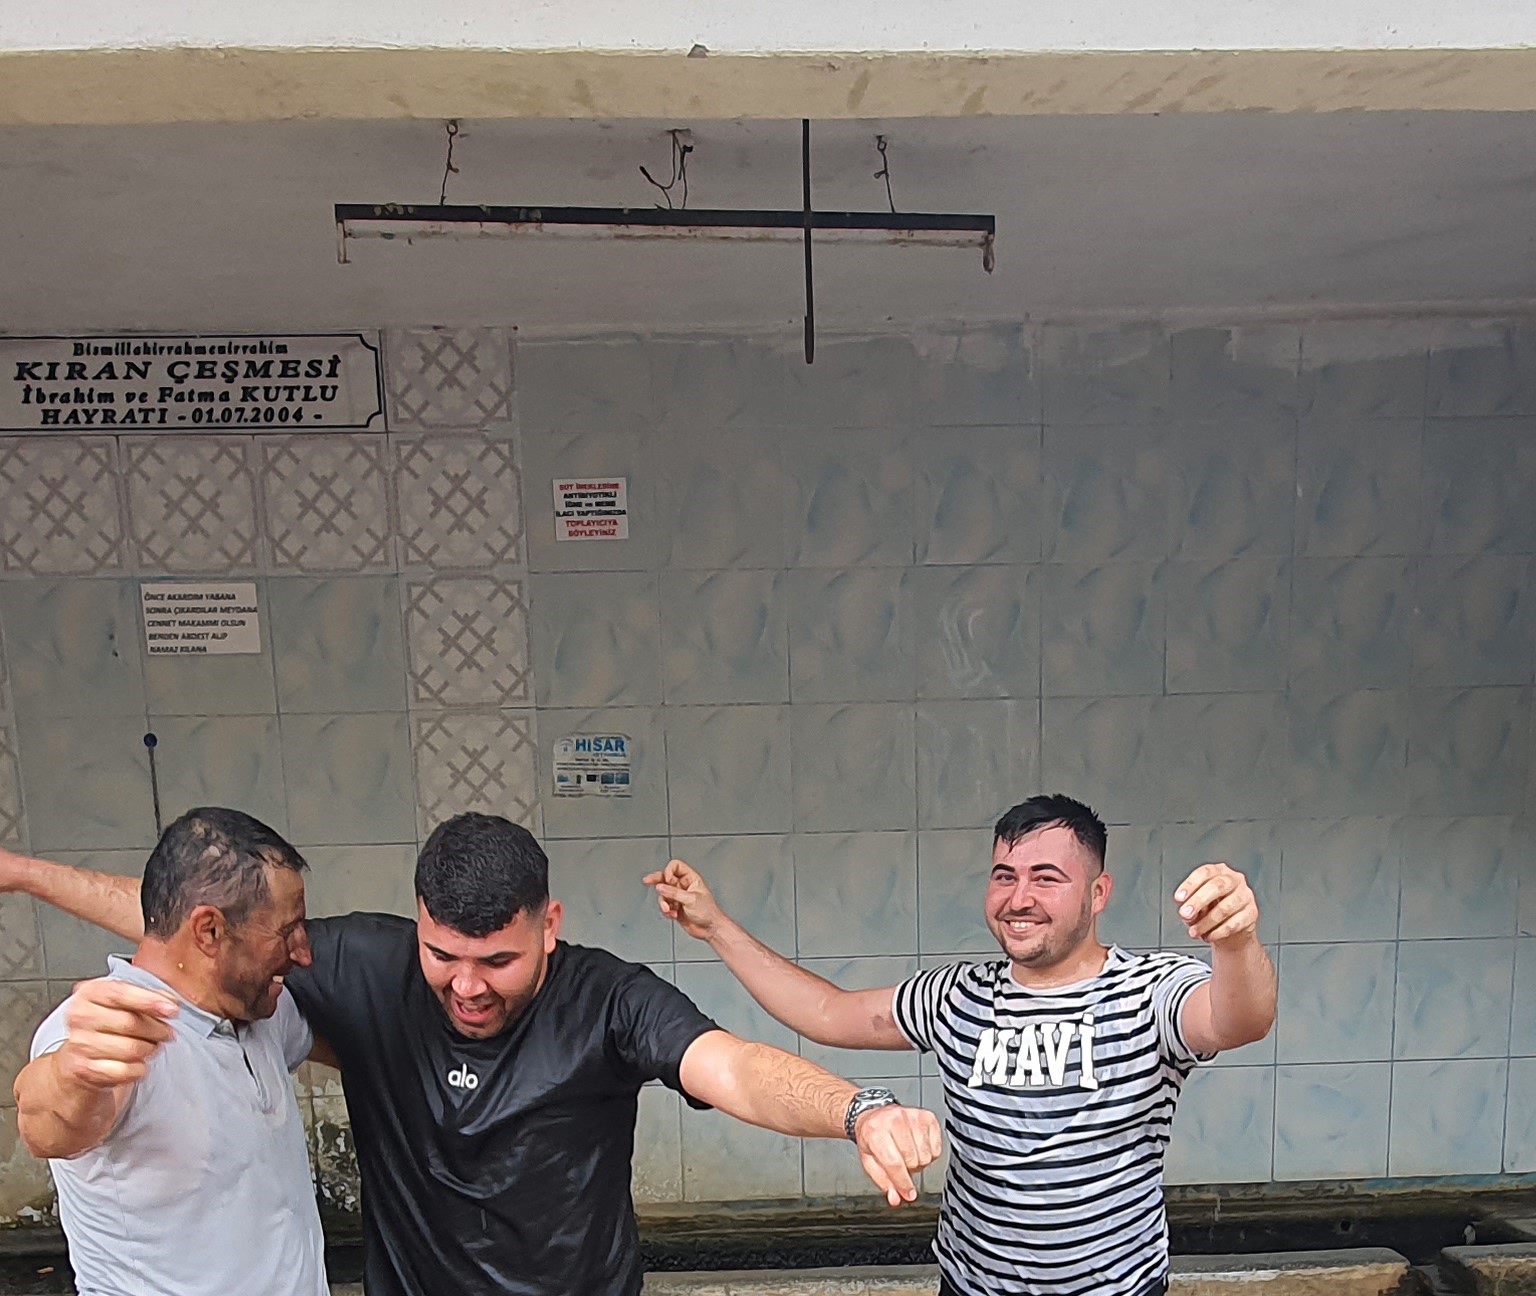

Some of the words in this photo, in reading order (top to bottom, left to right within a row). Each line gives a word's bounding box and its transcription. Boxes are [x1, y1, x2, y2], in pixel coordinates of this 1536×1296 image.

[14, 361, 152, 381] KIRAN
[167, 354, 341, 384] ÇEŞMESİ
[22, 384, 115, 404] İbrahim
[125, 392, 148, 403] ve
[157, 386, 230, 403] Fatma
[240, 385, 338, 402] KUTLU
[41, 408, 168, 424] HAYRATI
[192, 407, 303, 423] 01.07.2004
[967, 1012, 1099, 1090] MAVİ
[447, 1063, 479, 1089] alo
